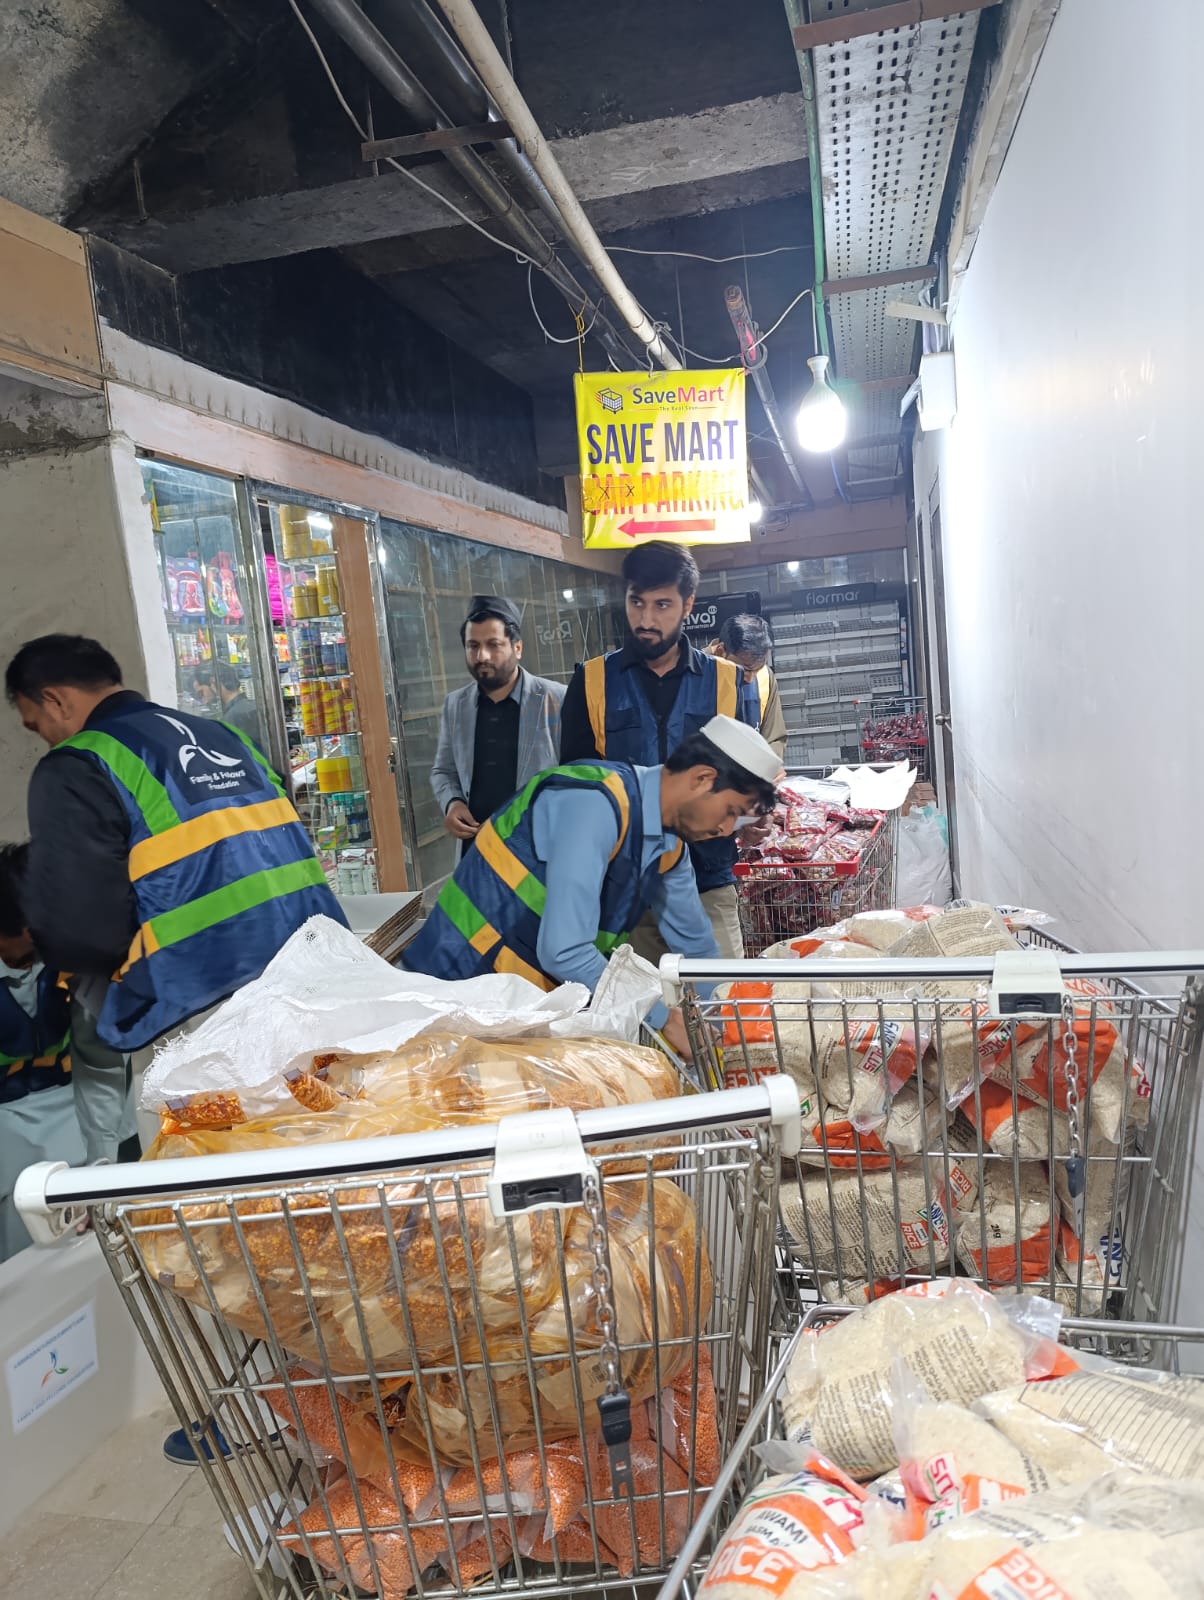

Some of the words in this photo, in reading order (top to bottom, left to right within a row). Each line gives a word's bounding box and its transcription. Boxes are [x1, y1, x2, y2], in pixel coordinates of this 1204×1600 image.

[632, 386, 724, 404] SaveMart
[586, 423, 655, 465] SAVE
[664, 420, 738, 462] MART
[806, 591, 859, 605] flormar
[952, 1168, 972, 1193] RICE
[902, 1224, 920, 1249] RICE
[755, 1509, 809, 1546] AWAMI
[709, 1545, 794, 1585] RICE
